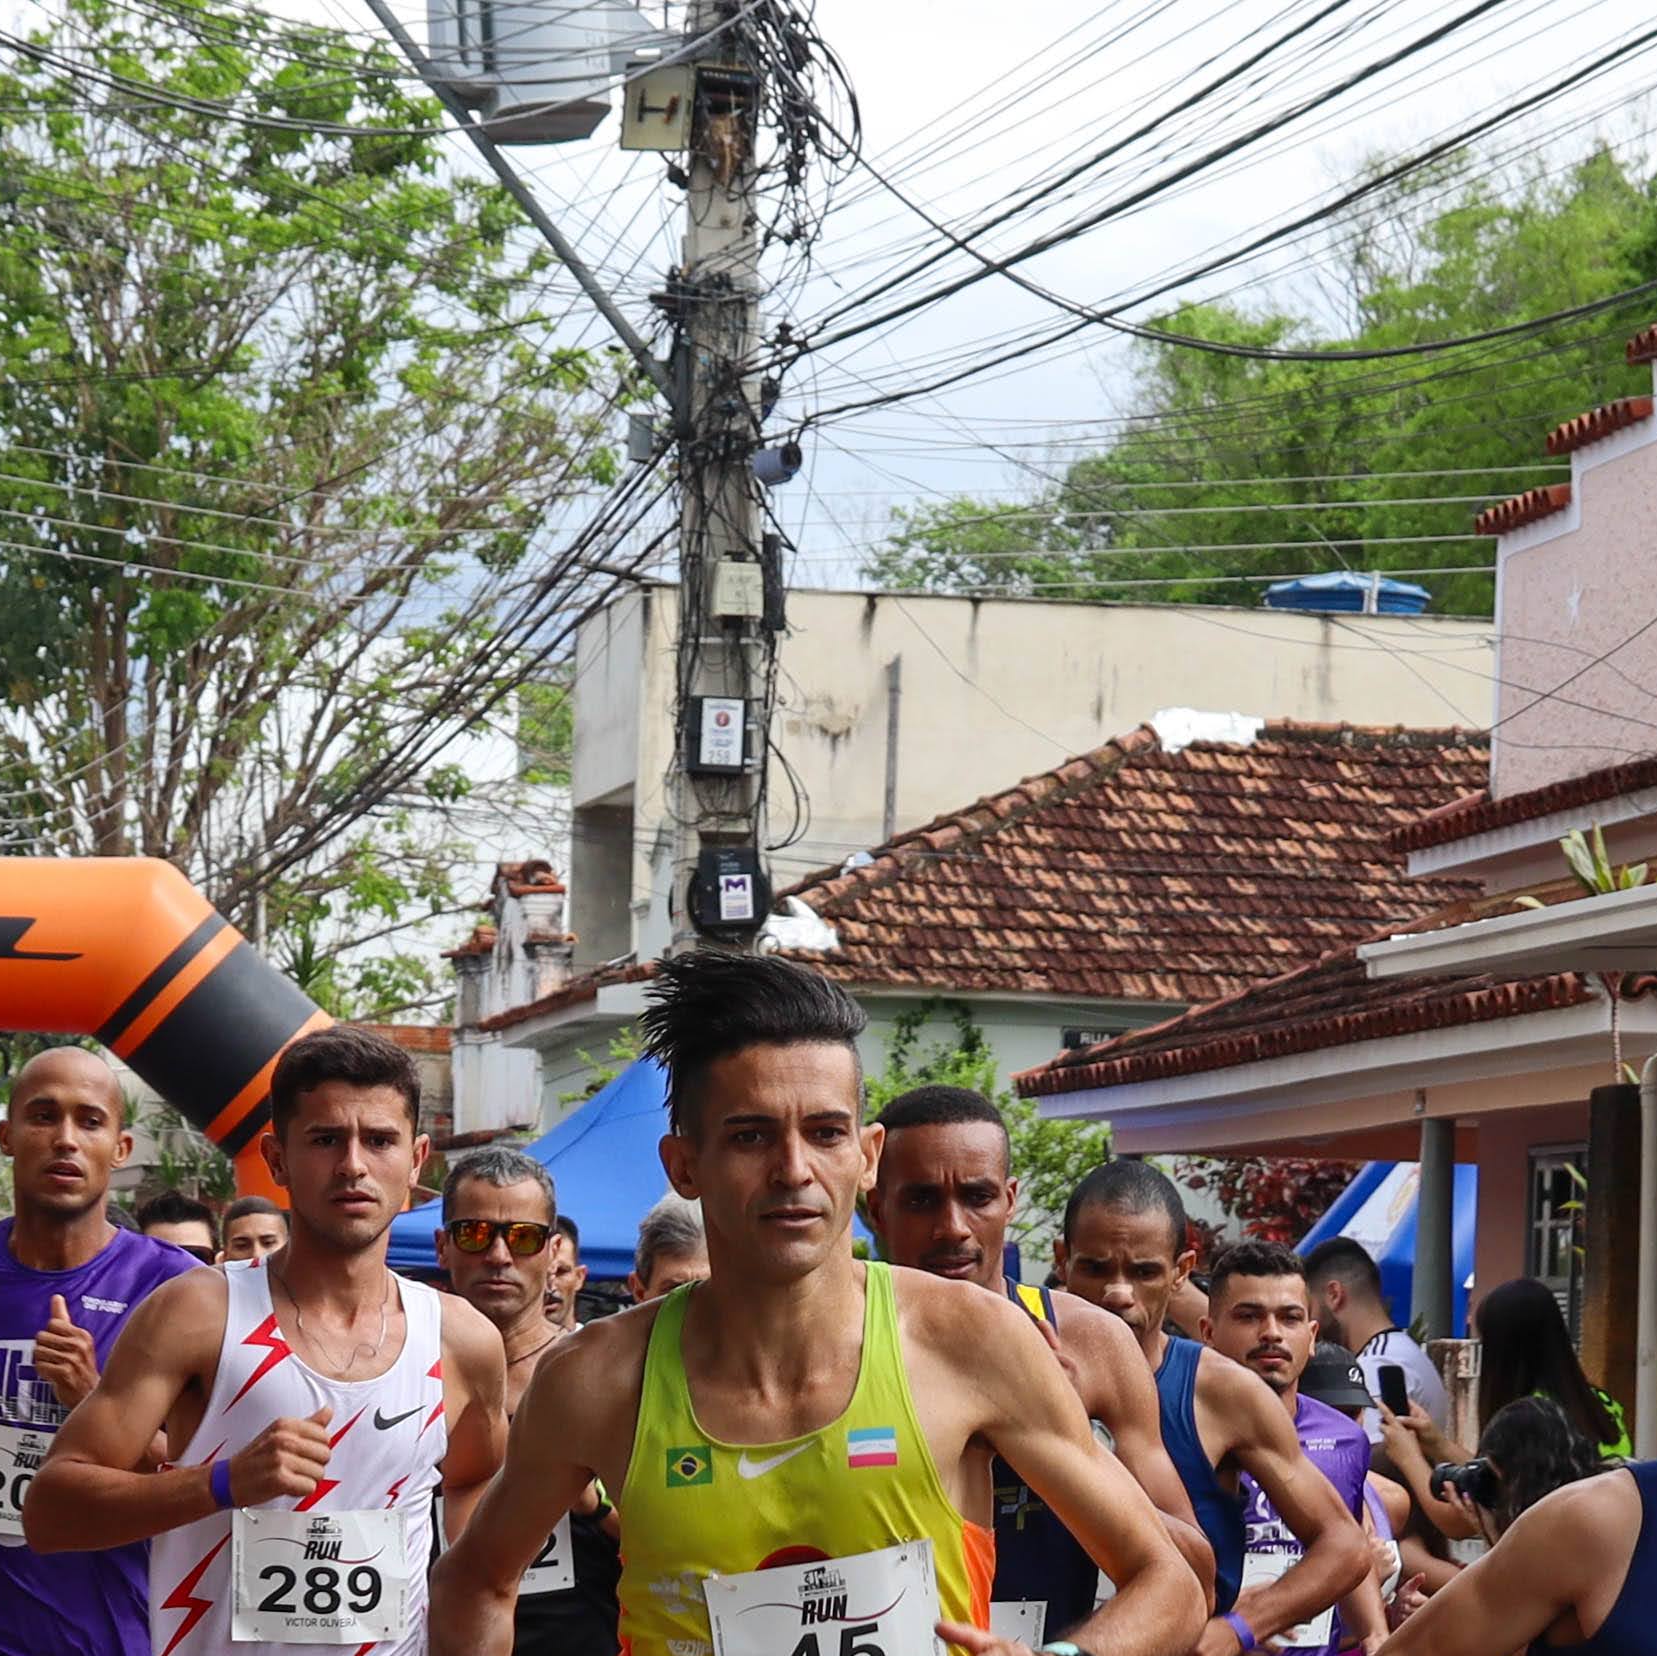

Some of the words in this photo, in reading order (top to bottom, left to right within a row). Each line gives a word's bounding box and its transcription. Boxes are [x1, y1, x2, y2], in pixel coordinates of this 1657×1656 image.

[303, 1540, 344, 1561] RUN
[257, 1565, 383, 1615] 289
[285, 1617, 317, 1628] VICTOR
[319, 1617, 357, 1628] OLIVEIRA
[801, 1595, 848, 1626] RUN
